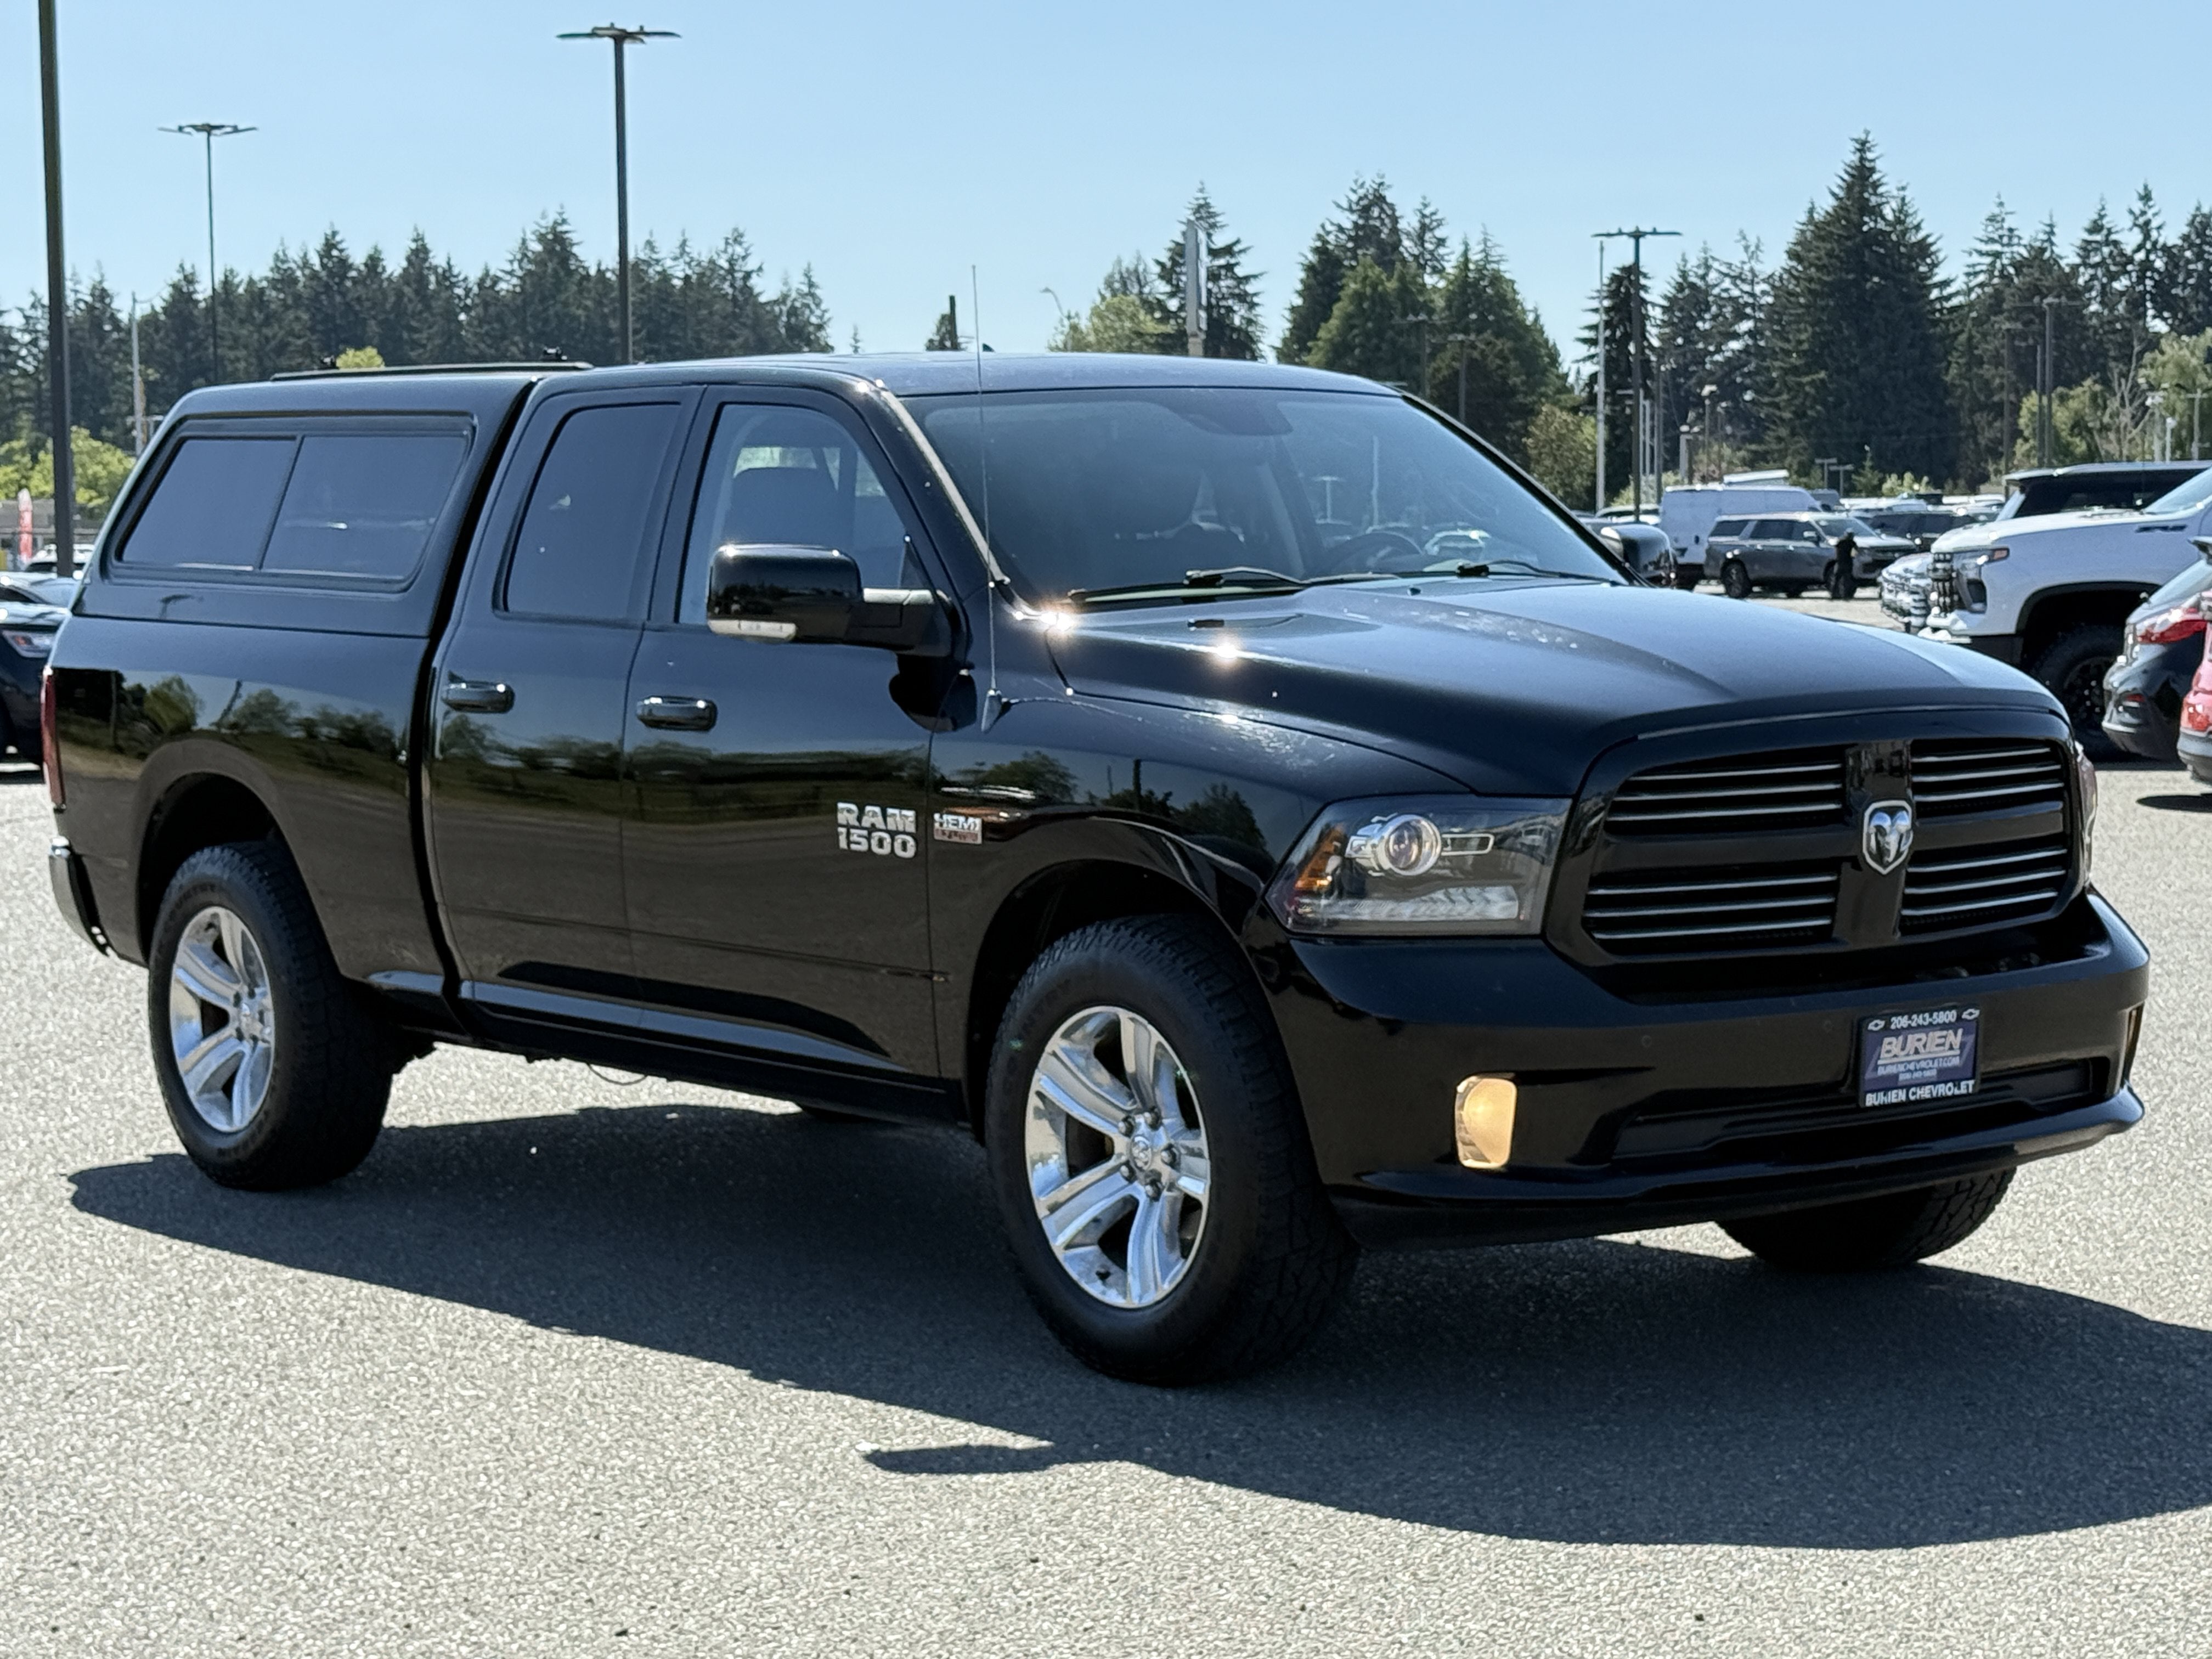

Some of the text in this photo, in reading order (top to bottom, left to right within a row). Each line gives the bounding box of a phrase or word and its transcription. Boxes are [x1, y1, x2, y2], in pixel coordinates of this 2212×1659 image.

[837, 802, 916, 833] RAM
[934, 813, 981, 831] HEMI
[838, 827, 916, 859] 1500
[1891, 1010, 1957, 1030] 206-243-5800
[1880, 1028, 1963, 1059] BURIEN
[1866, 1080, 1975, 1107] BURIEN CHEVROLET
